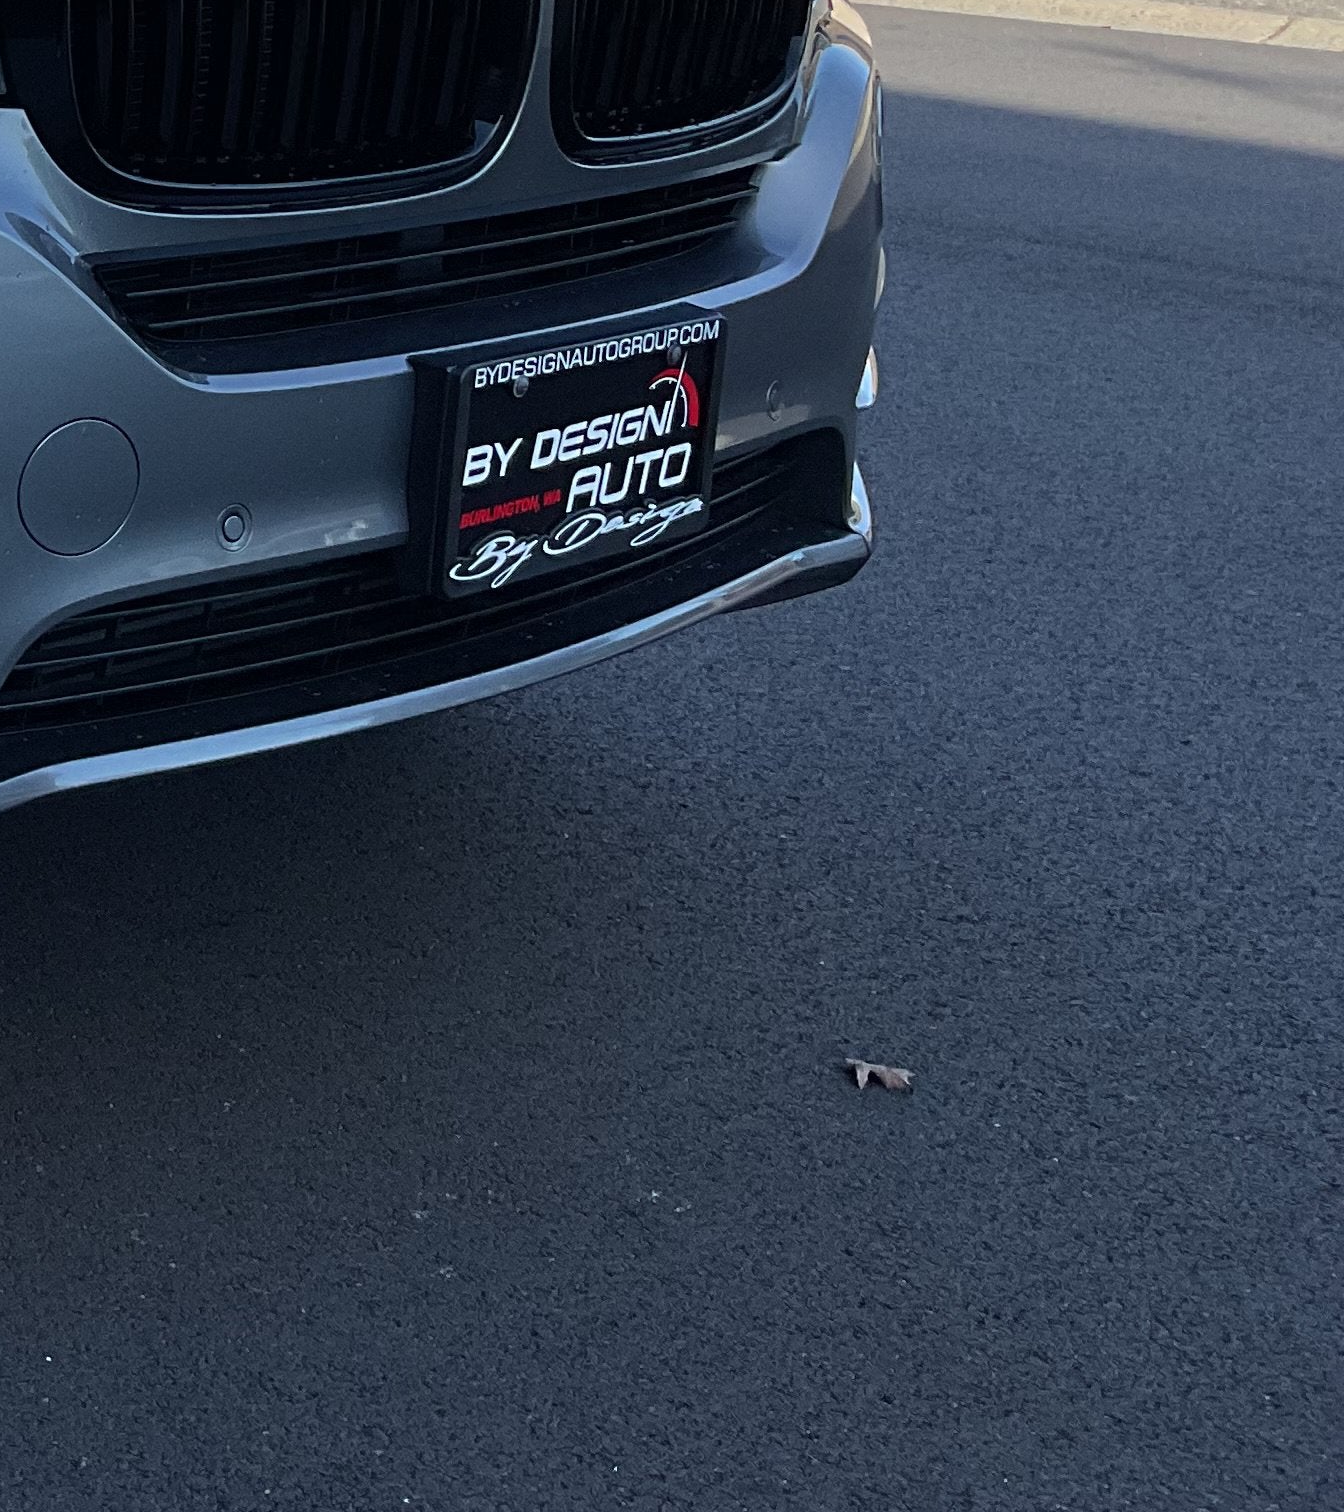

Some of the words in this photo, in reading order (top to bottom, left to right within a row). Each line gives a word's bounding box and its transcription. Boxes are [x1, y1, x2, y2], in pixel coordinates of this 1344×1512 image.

[474, 319, 720, 389] BYDESIGNAUTOGROUPCOM
[462, 438, 523, 487] BY
[530, 399, 674, 470] DESIGN
[565, 441, 692, 513] AUTO
[448, 536, 539, 590] By
[542, 497, 704, 556] Design
